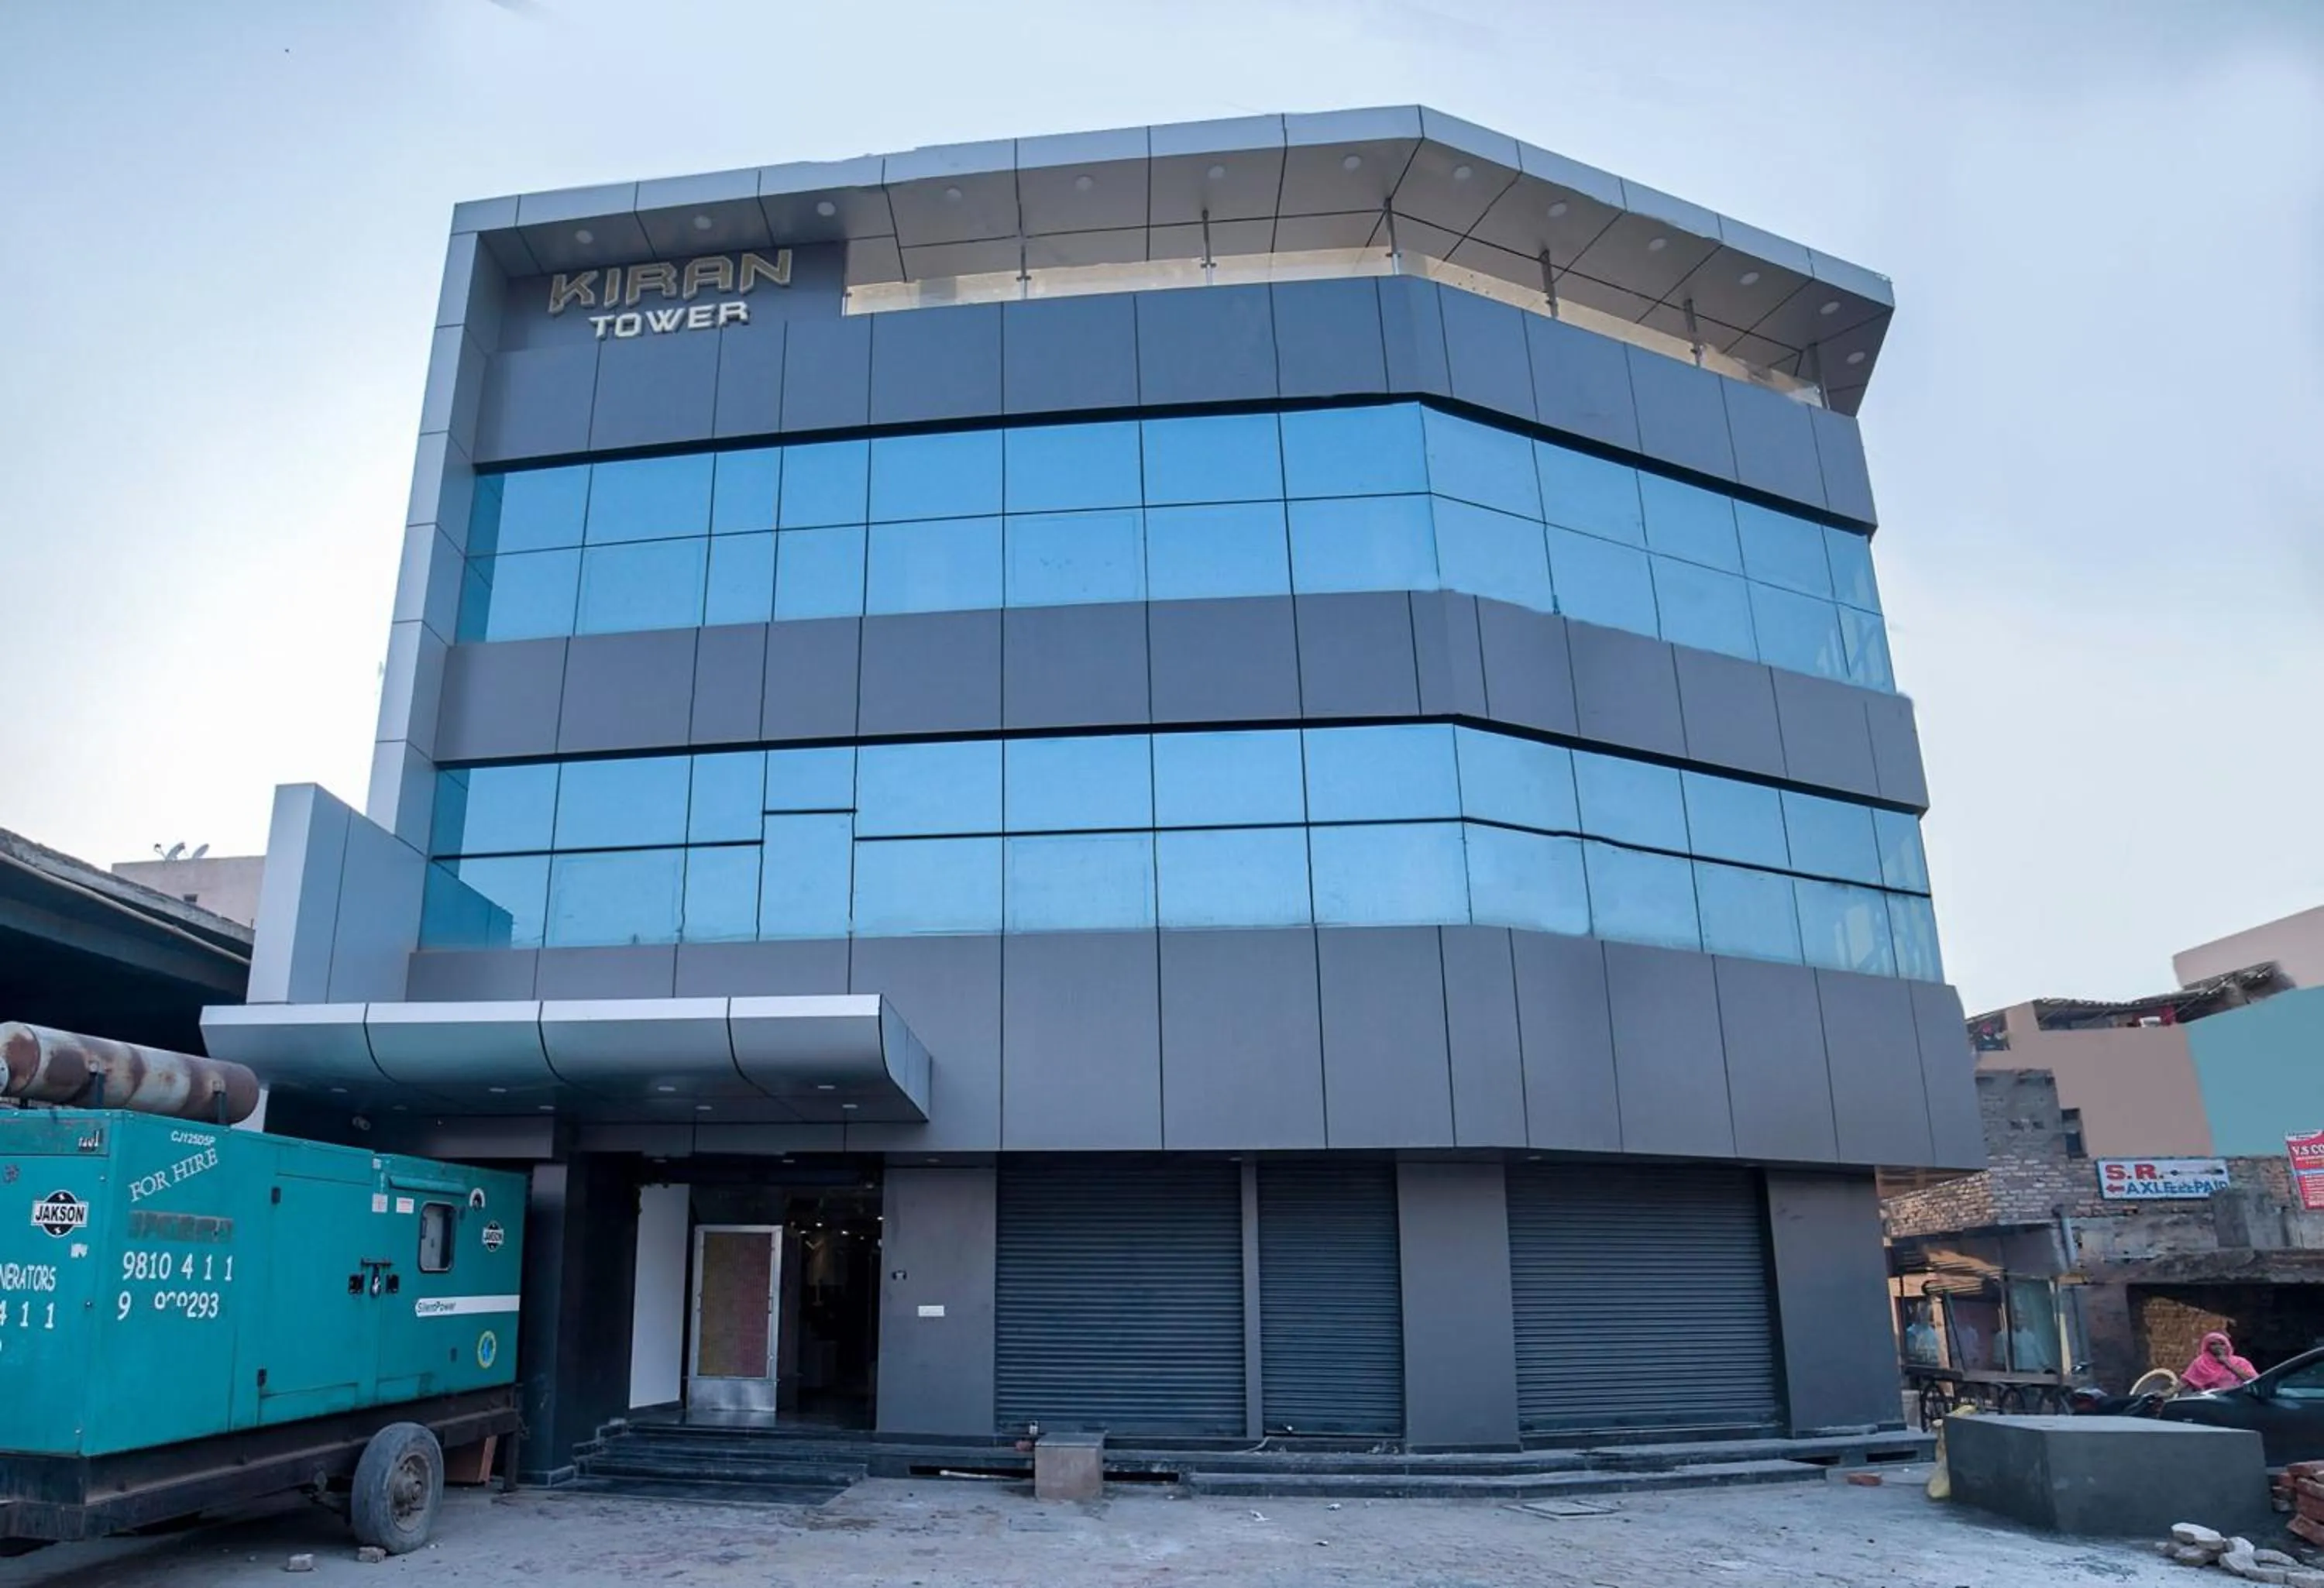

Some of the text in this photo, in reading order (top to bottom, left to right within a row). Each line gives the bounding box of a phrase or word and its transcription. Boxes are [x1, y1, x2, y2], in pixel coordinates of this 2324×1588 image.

[548, 249, 792, 315] KIRAN
[589, 301, 749, 339] TOWER
[128, 1147, 218, 1202] FOR HIRE
[35, 1205, 85, 1222] JAKSON
[122, 1249, 172, 1280] 9810
